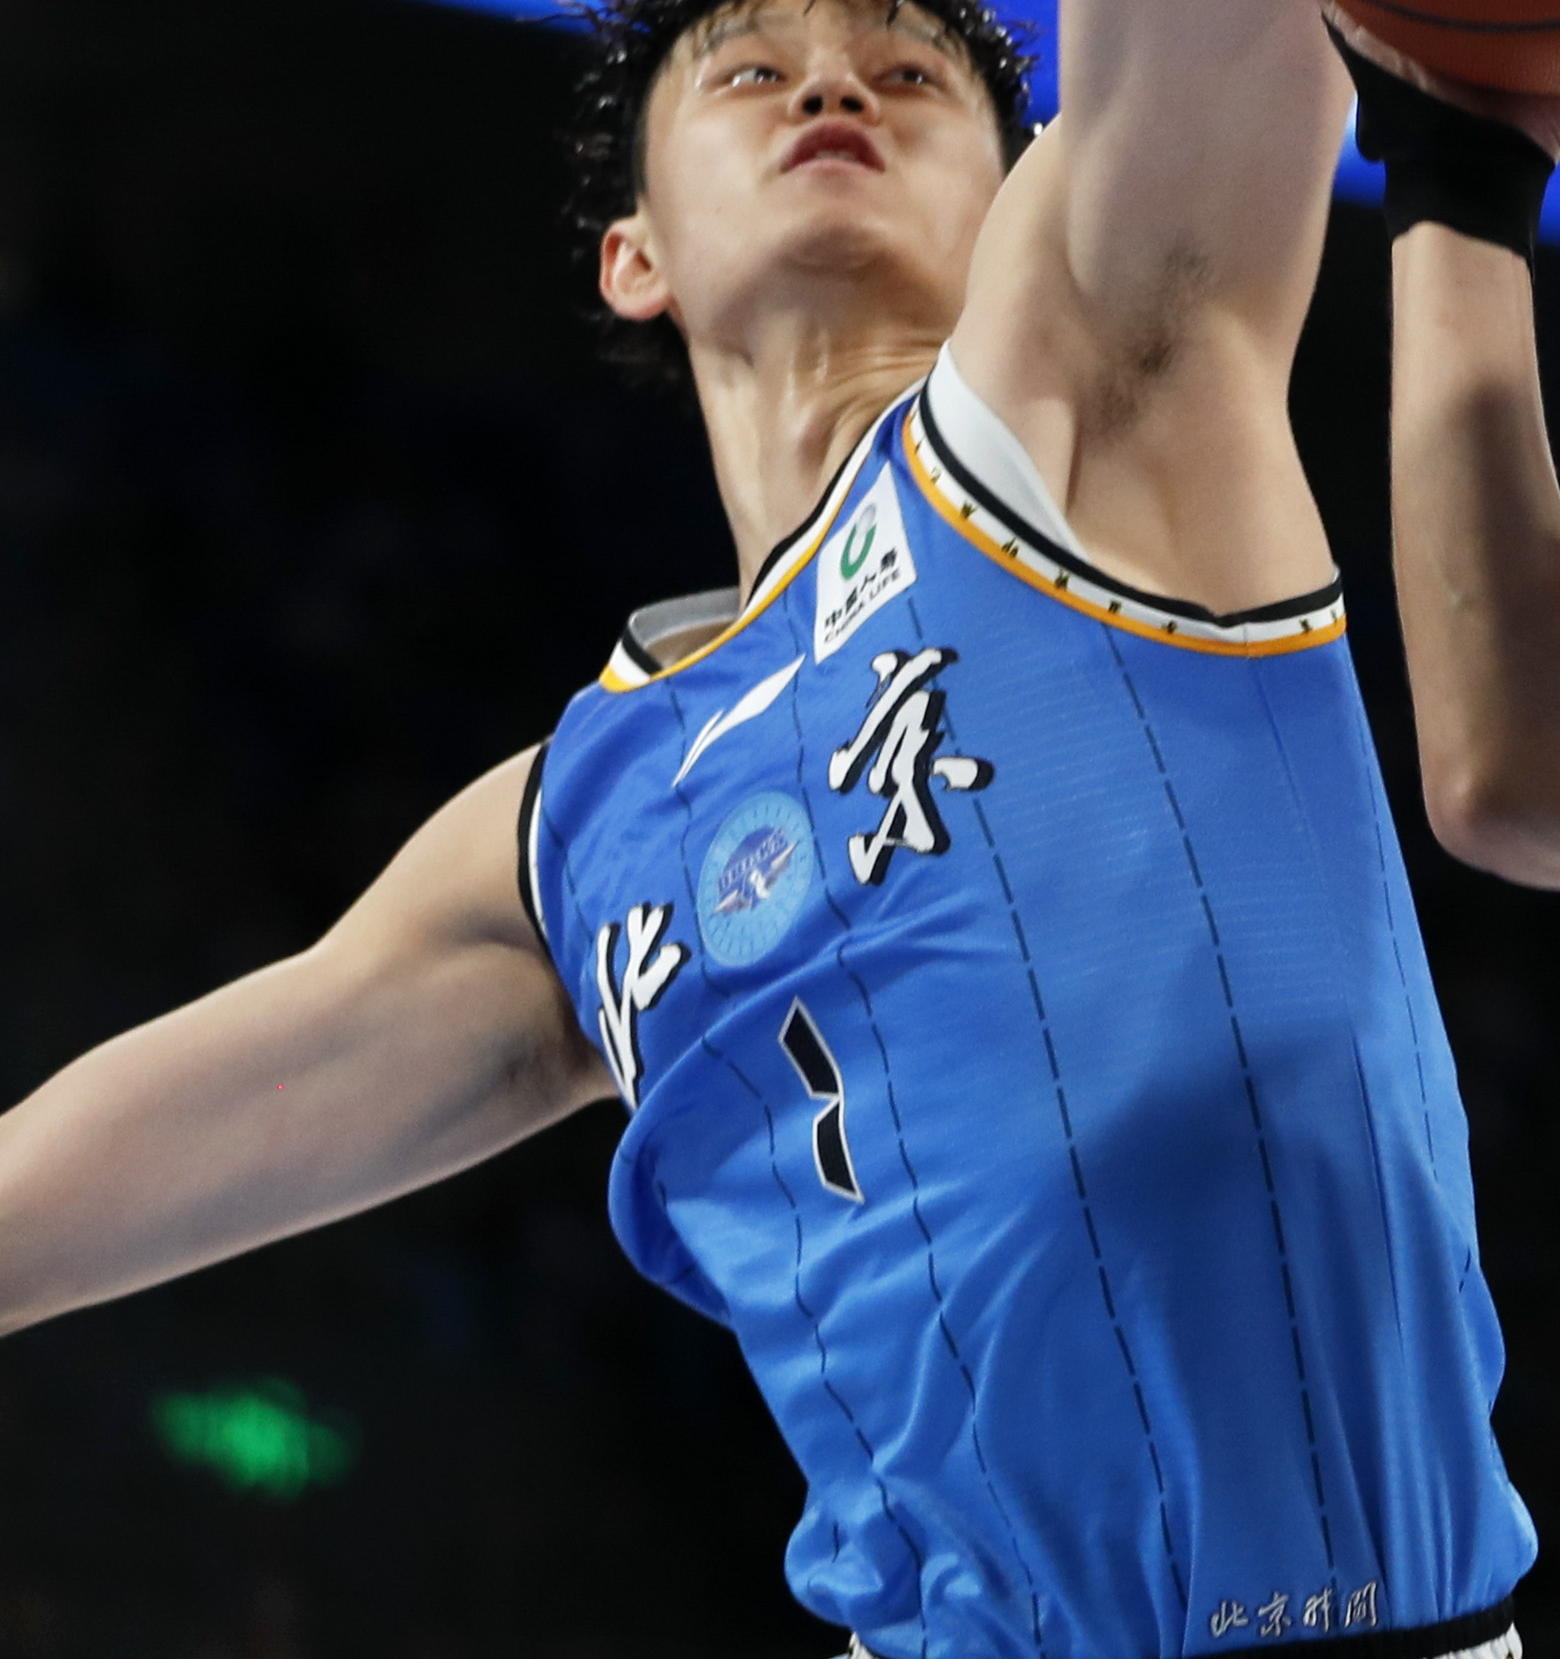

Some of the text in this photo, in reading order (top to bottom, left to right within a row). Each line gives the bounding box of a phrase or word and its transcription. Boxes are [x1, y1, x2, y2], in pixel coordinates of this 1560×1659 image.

[824, 547, 898, 630] 中国人寿
[869, 568, 901, 600] LIFE
[829, 648, 995, 885] 京
[777, 995, 864, 1204] 1
